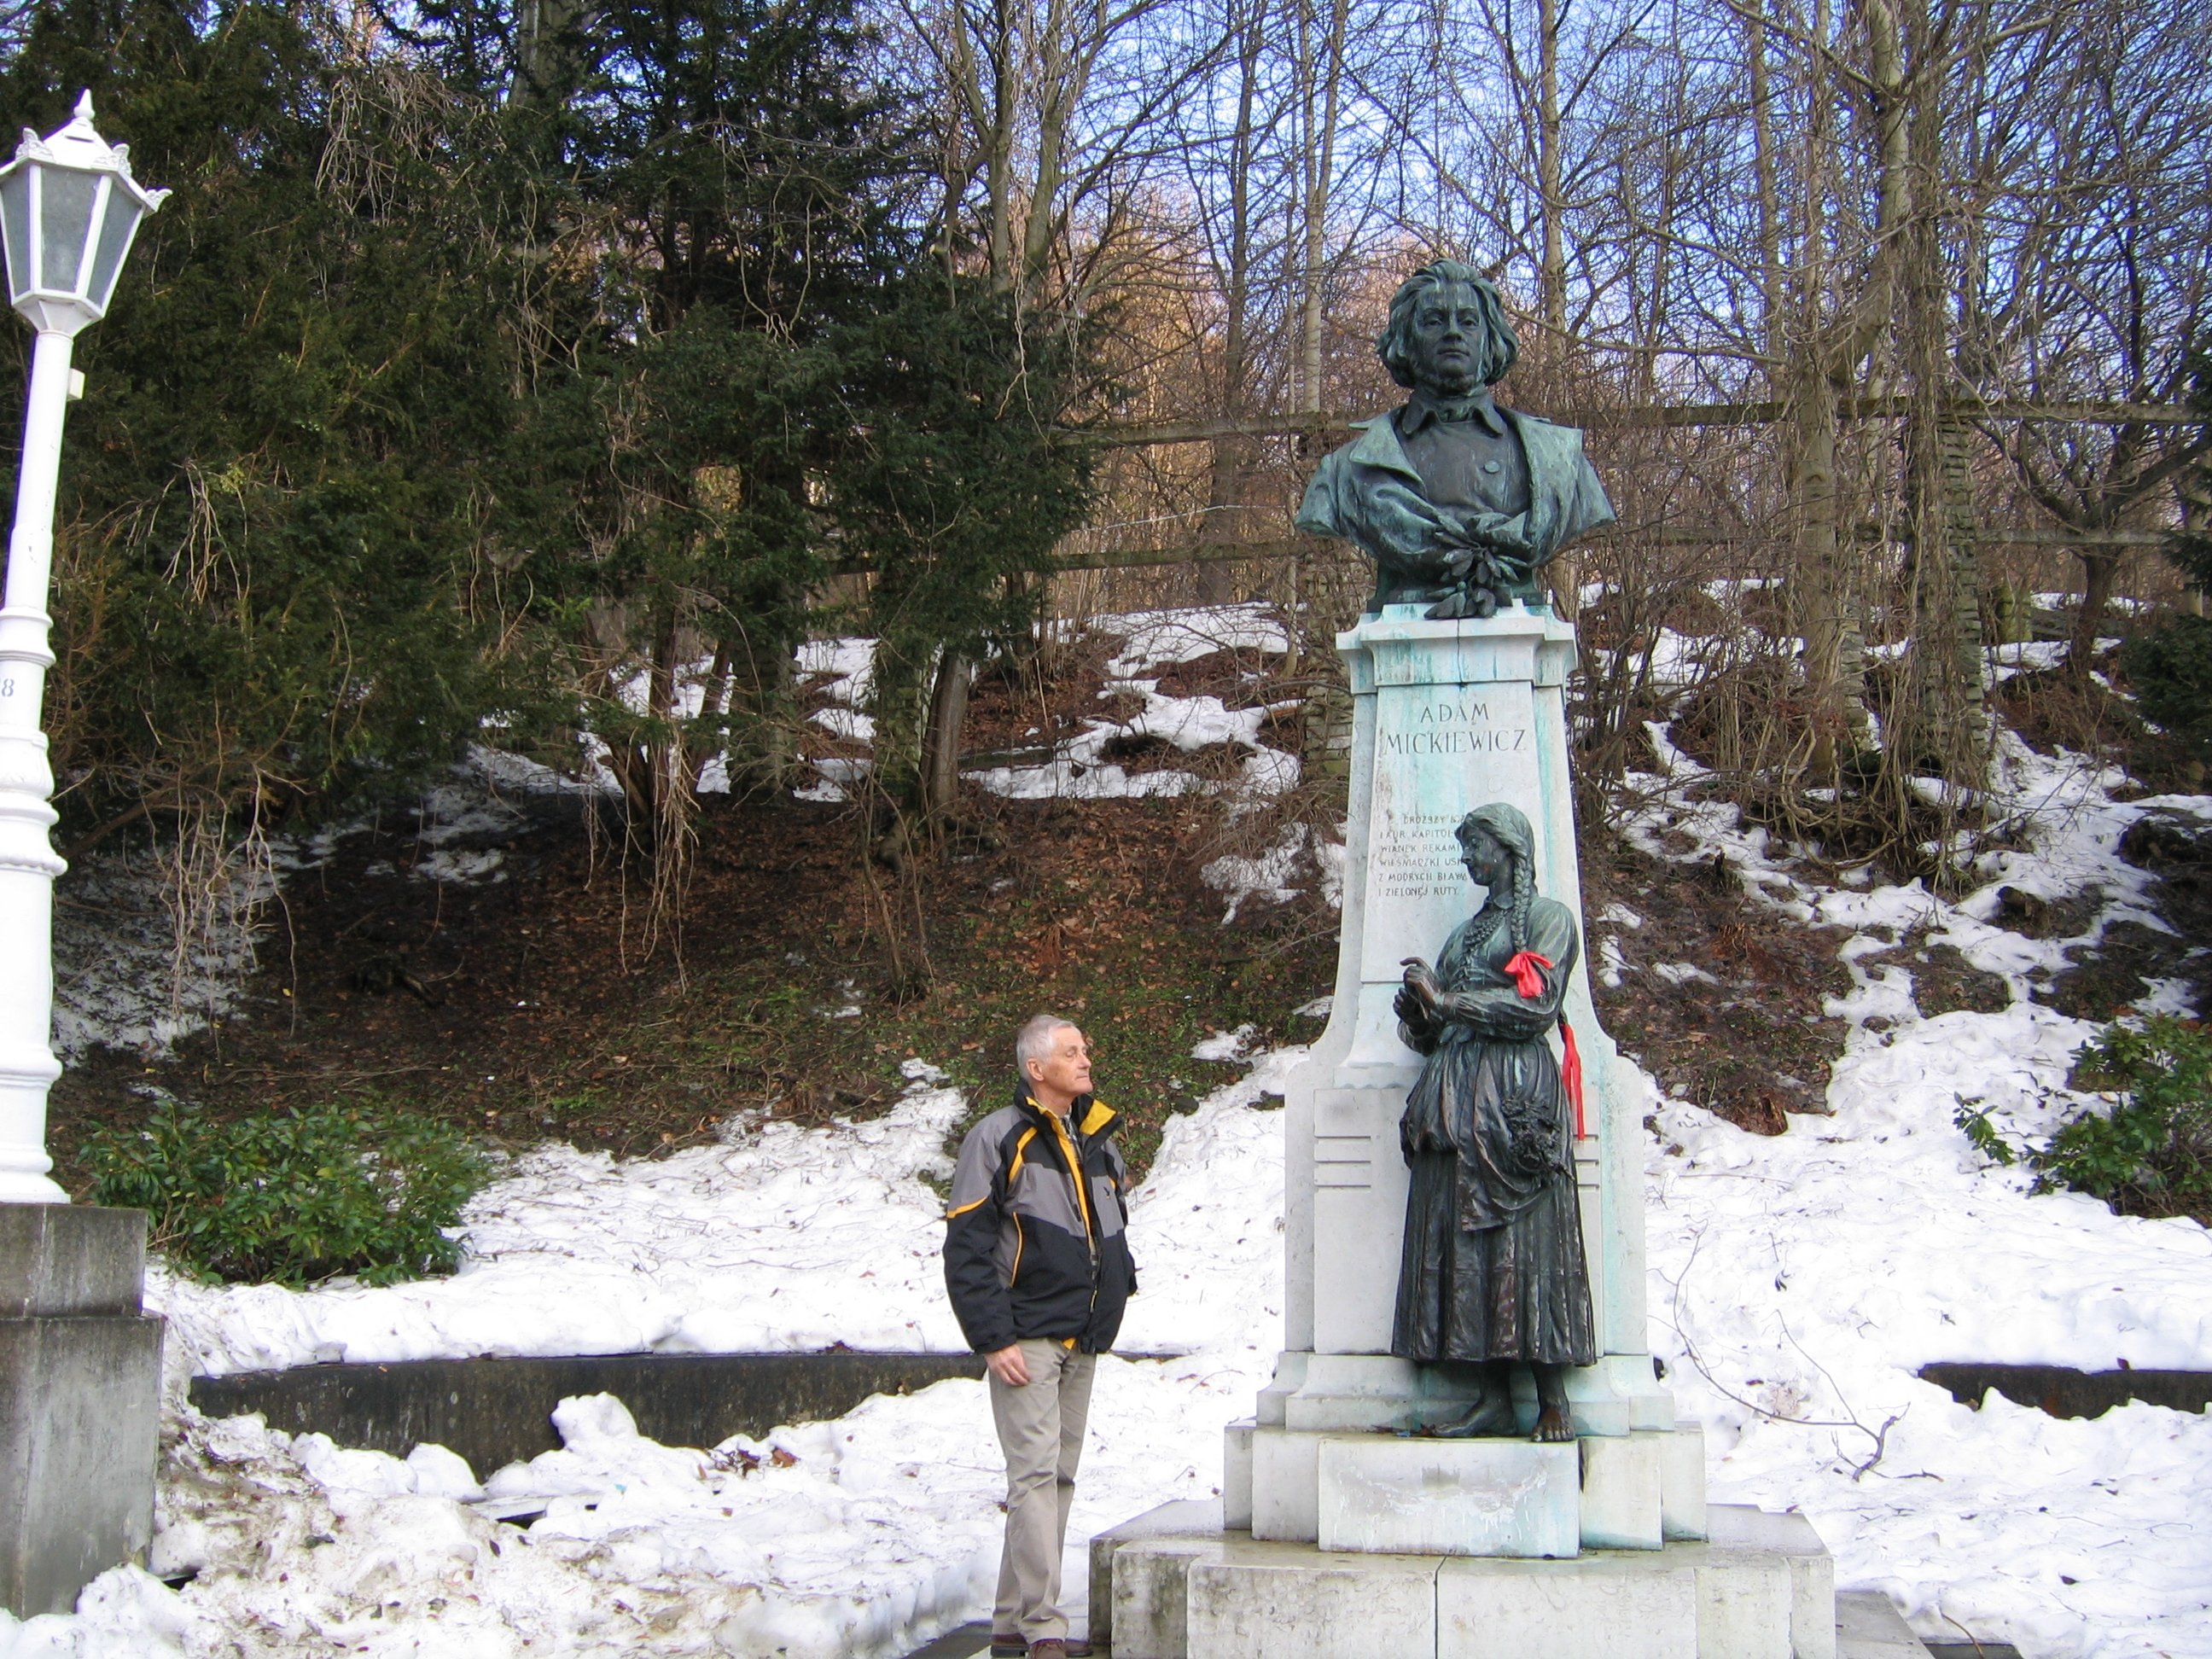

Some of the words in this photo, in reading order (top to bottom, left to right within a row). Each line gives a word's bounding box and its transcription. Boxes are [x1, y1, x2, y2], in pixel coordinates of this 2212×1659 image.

[1420, 702, 1489, 724] ADAM
[1384, 730, 1526, 754] MICKIEWICZ
[1378, 873, 1384, 882] Z
[1388, 872, 1432, 882] MODRYCH
